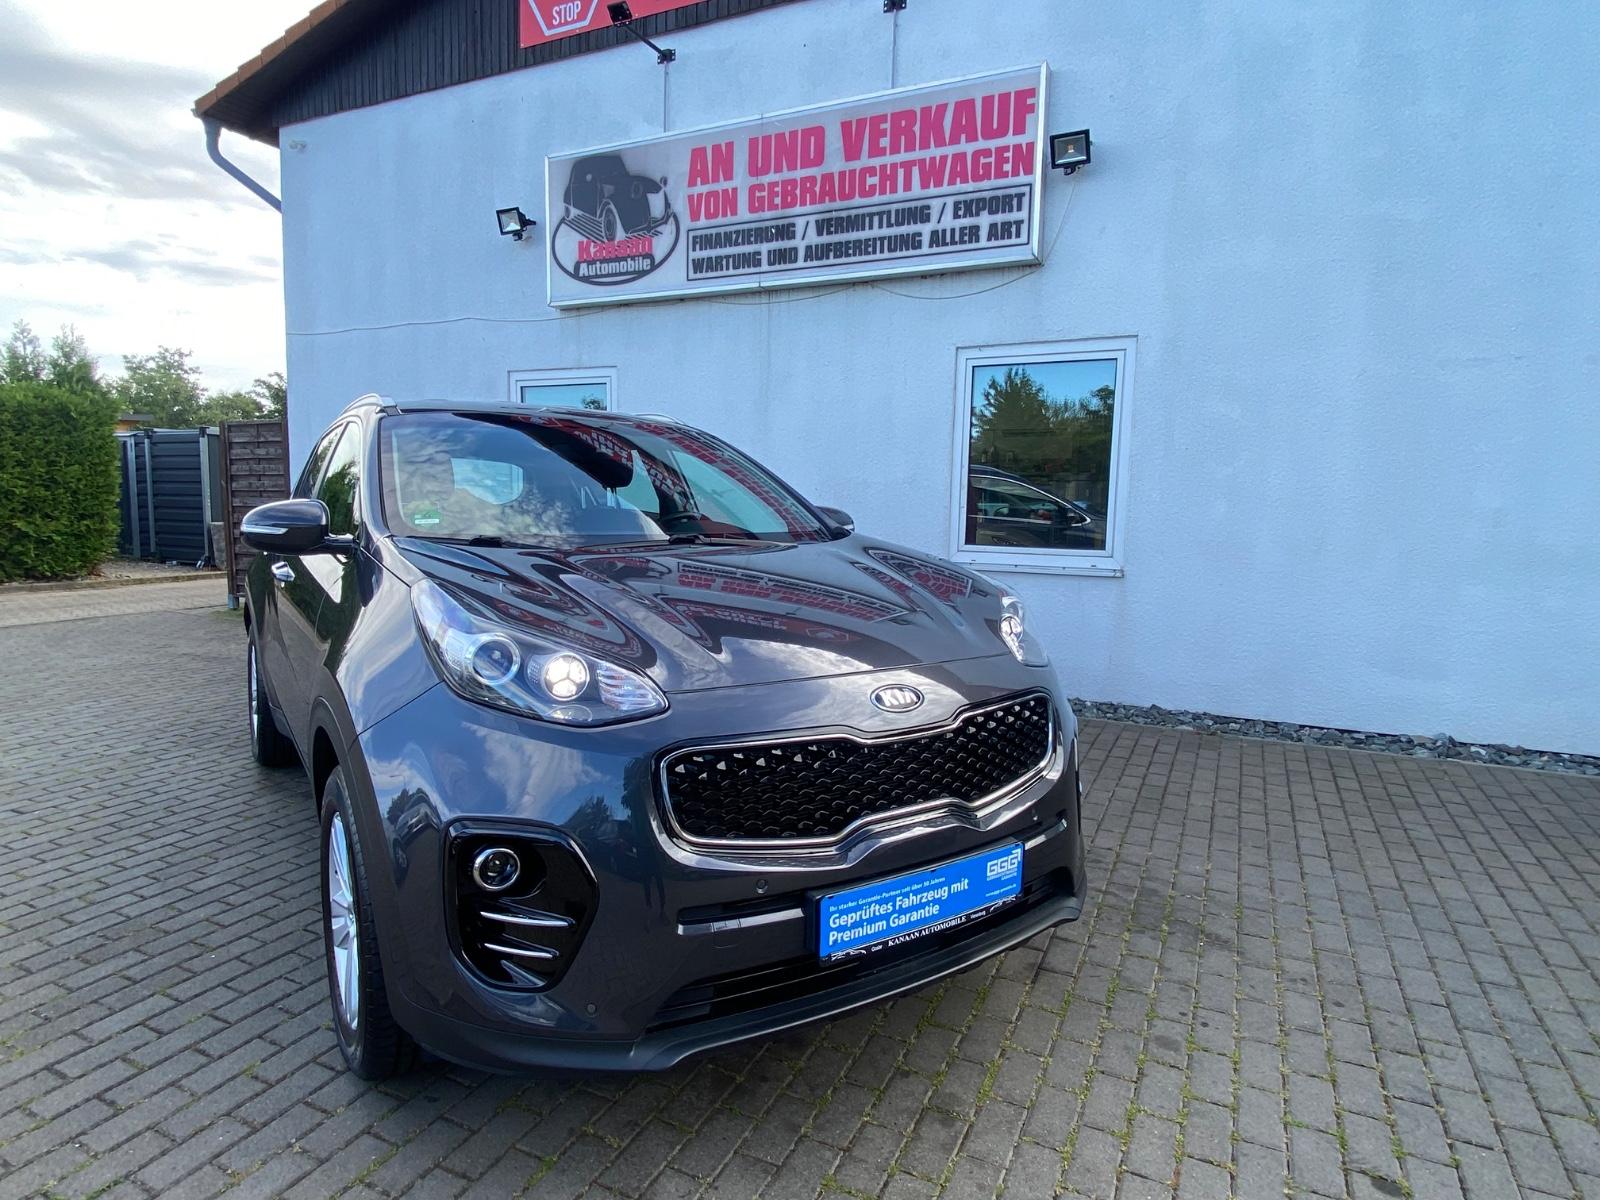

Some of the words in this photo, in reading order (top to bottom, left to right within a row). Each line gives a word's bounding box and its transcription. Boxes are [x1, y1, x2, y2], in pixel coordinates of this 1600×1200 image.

[552, 4, 581, 25] STOP
[688, 141, 734, 188] AN
[748, 125, 826, 178] UND
[841, 87, 1036, 162] VERKAUF
[688, 187, 738, 222] VON
[747, 142, 1035, 214] GEBRAUCHTWAGEN
[691, 222, 796, 252] FINANZIERUNG
[815, 202, 931, 236] VERMITTLUNG
[953, 192, 1026, 220] EXPORT
[579, 257, 651, 277] Automobile
[692, 250, 762, 275] WARTUNG
[767, 246, 799, 267] UND
[803, 230, 923, 263] AUFBEREITUNG
[928, 223, 981, 250] ALLER
[986, 219, 1025, 243] ART
[987, 854, 1018, 877] GGG
[829, 902, 893, 928] Geprüftes
[895, 886, 949, 911] Fahrzeug
[950, 878, 969, 894] mit
[829, 920, 887, 946] Premium
[889, 903, 940, 928] Garantie
[888, 930, 920, 946] KANAAN
[920, 915, 967, 937] AUTOMOBILE
